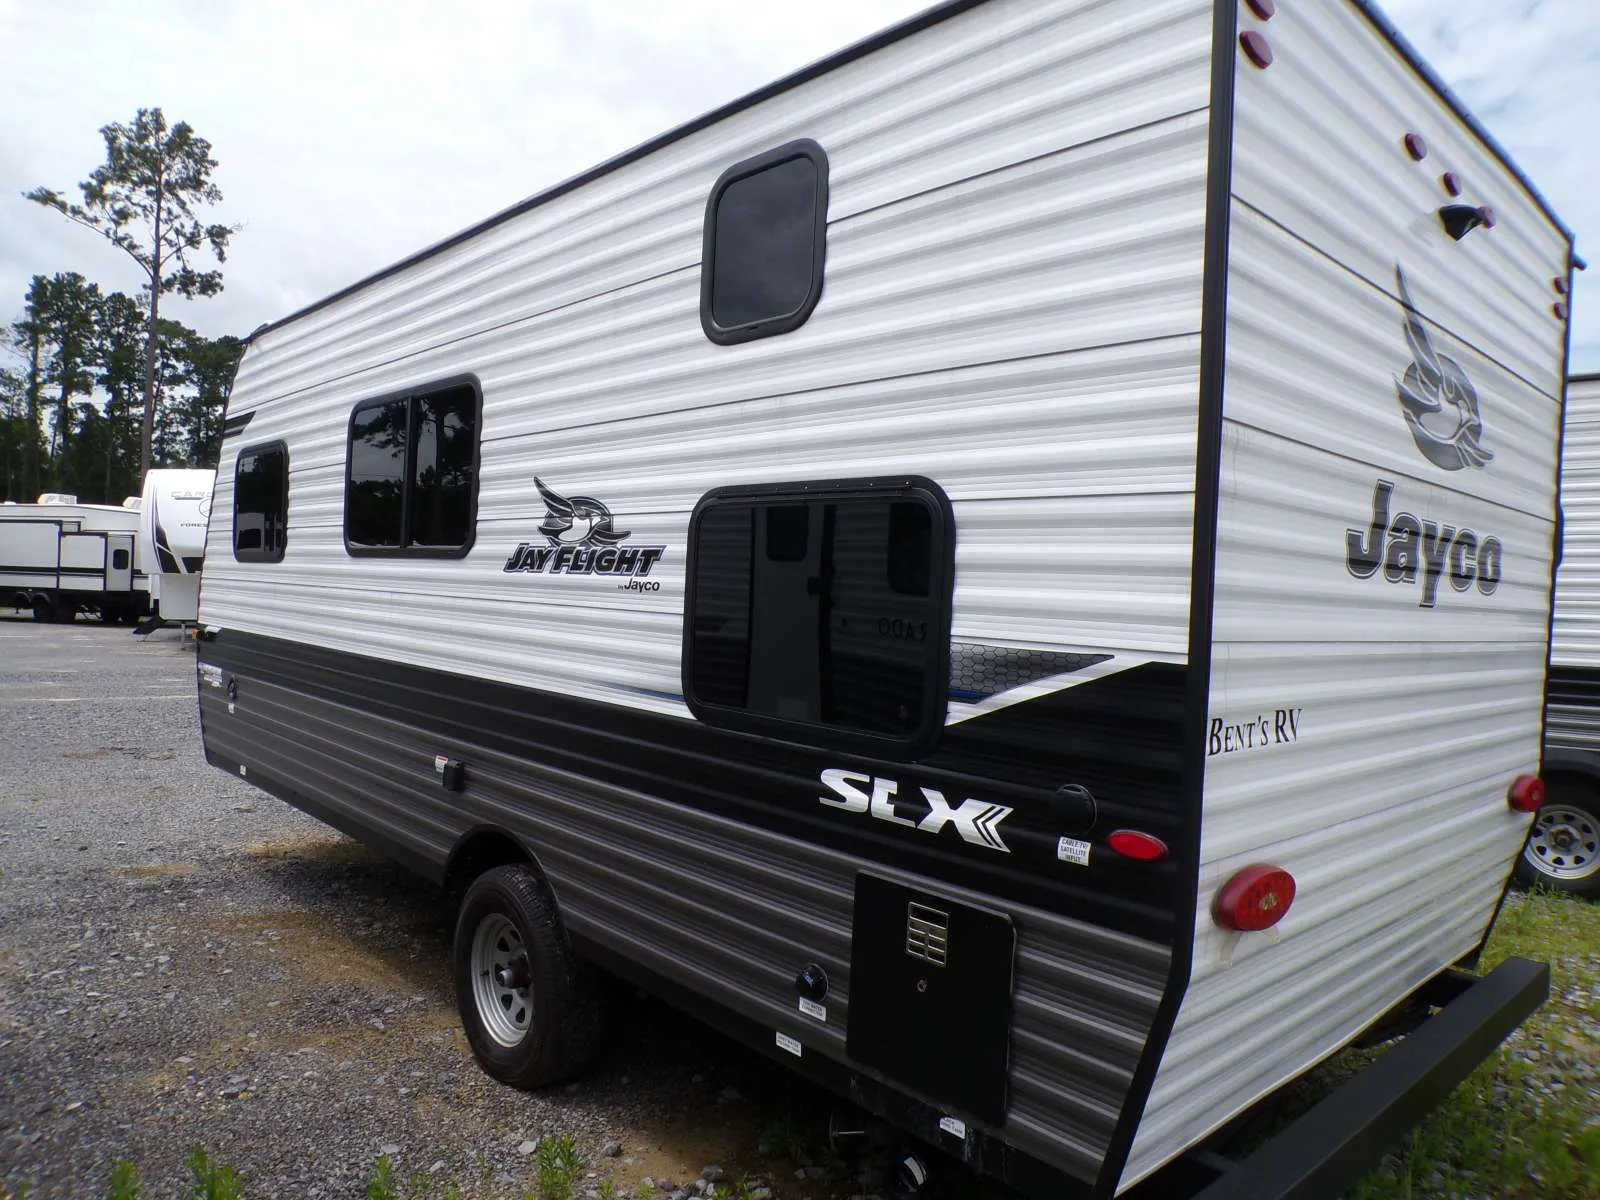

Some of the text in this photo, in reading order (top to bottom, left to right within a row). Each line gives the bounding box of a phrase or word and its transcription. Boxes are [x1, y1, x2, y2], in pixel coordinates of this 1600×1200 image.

[503, 543, 667, 577] JAY FLIGHT
[1346, 479, 1503, 608] Jayco
[624, 577, 660, 593] Jayco
[1274, 708, 1303, 744] RV
[819, 768, 1014, 853] SLX
